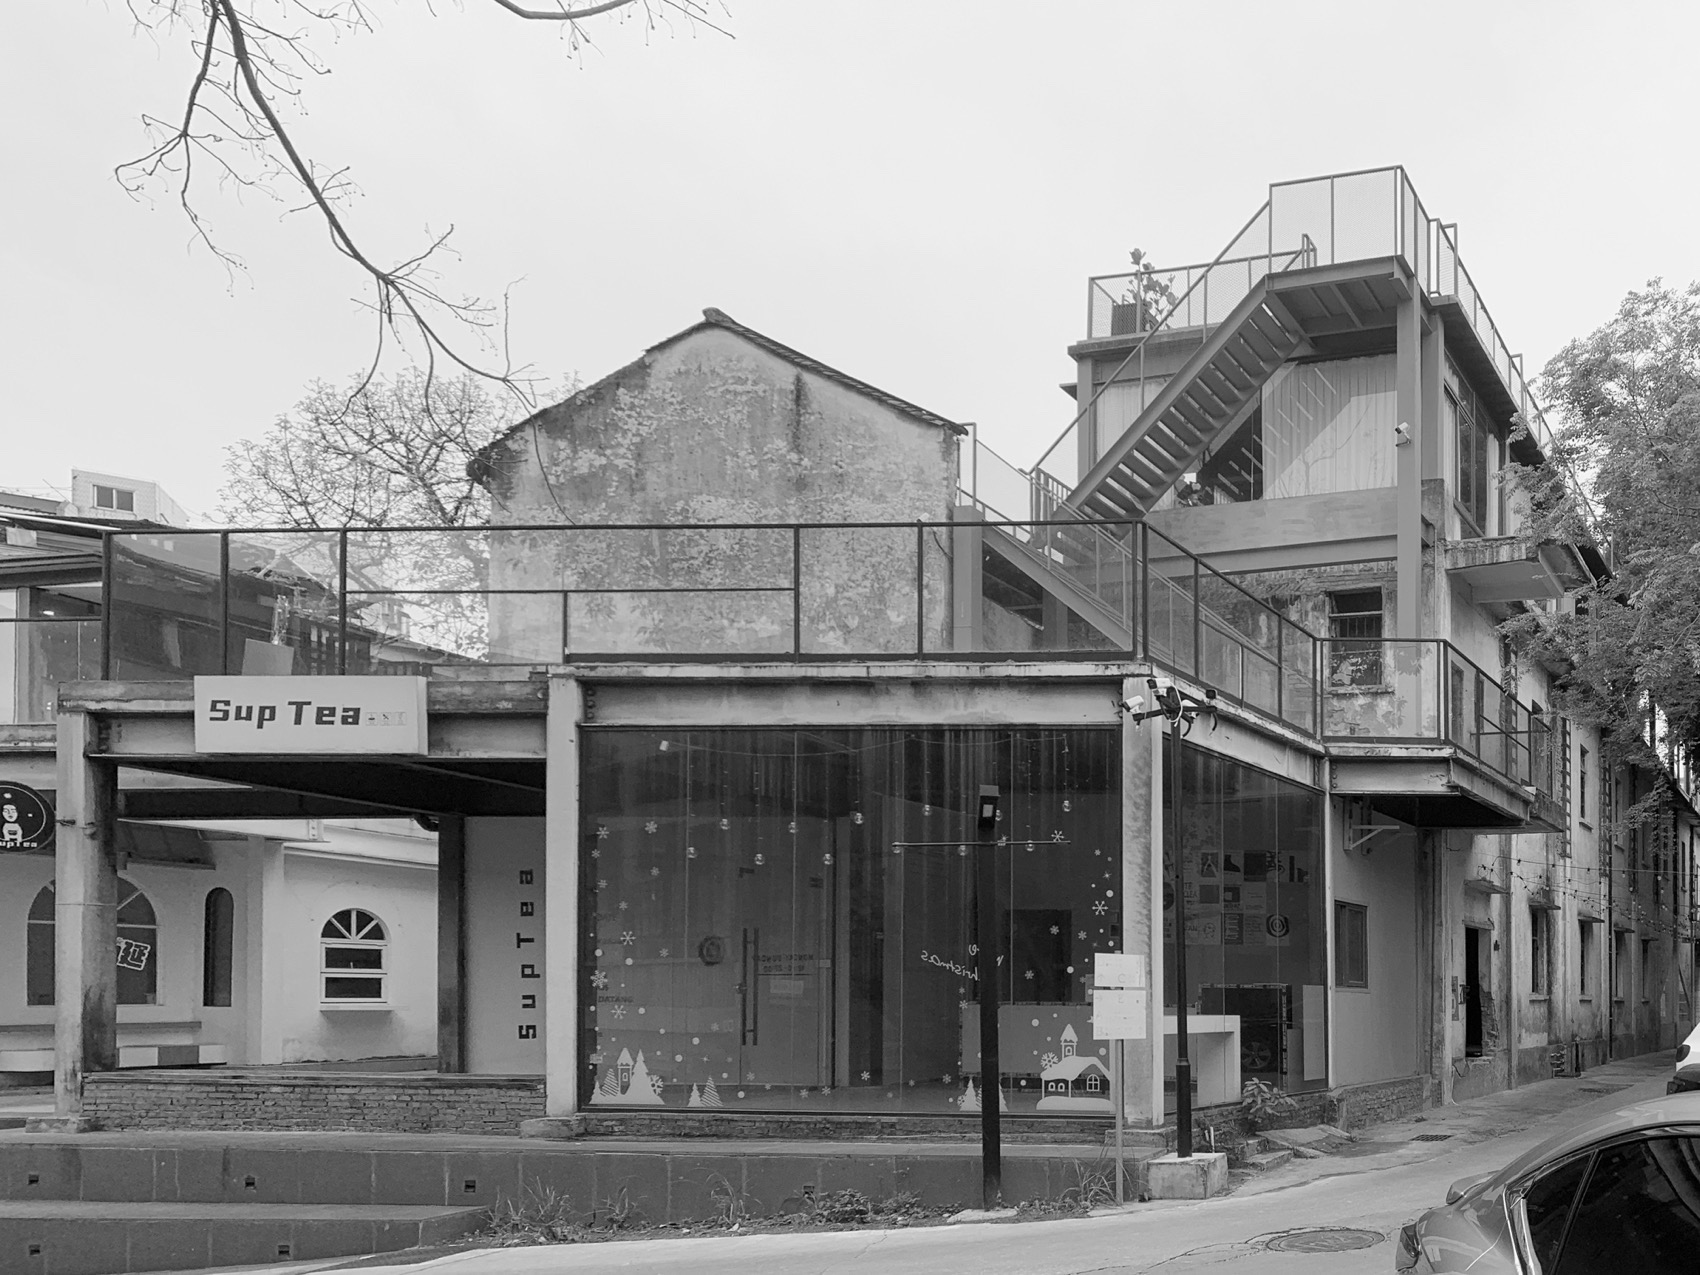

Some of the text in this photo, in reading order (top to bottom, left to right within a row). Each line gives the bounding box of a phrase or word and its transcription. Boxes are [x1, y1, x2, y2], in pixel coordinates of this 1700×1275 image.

[209, 700, 361, 729] Sup Tea
[0, 840, 38, 849] upTea
